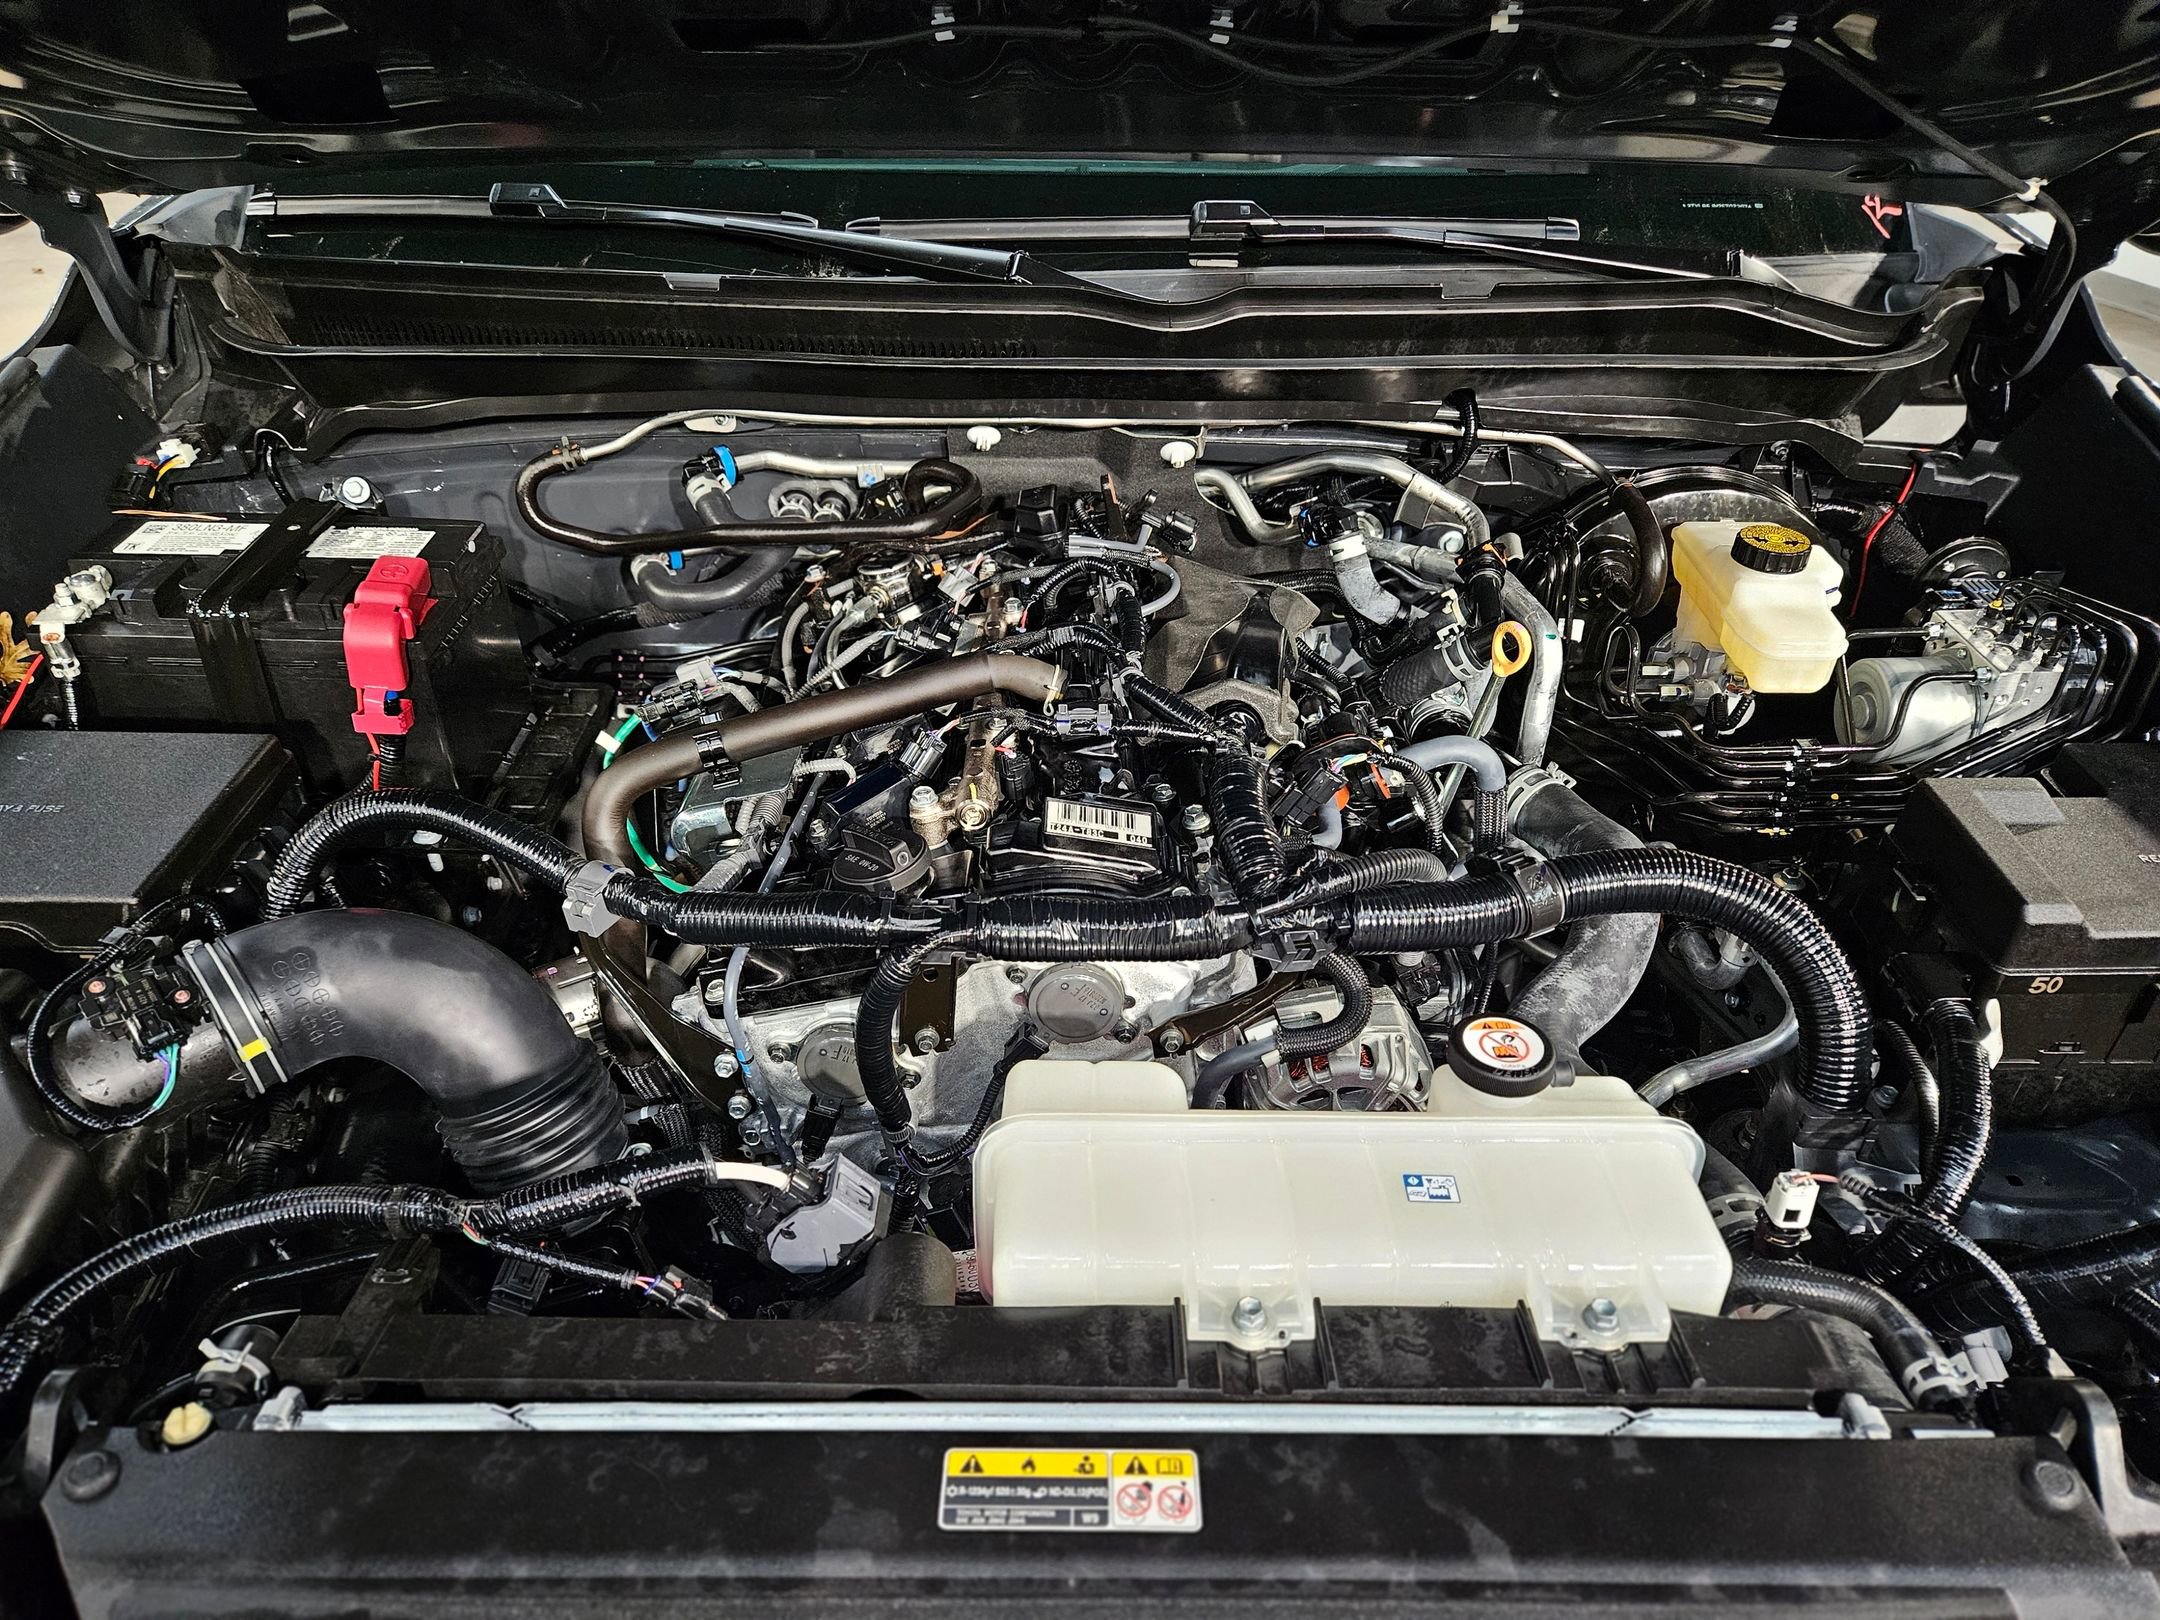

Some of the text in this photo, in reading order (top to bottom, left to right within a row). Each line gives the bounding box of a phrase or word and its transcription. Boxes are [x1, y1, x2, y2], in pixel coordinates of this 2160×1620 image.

[25, 804, 66, 813] FUSE
[1129, 834, 1149, 845] 040
[845, 854, 879, 872] SAE 0W-20
[2137, 854, 2160, 864] RE
[2028, 976, 2064, 994] 50
